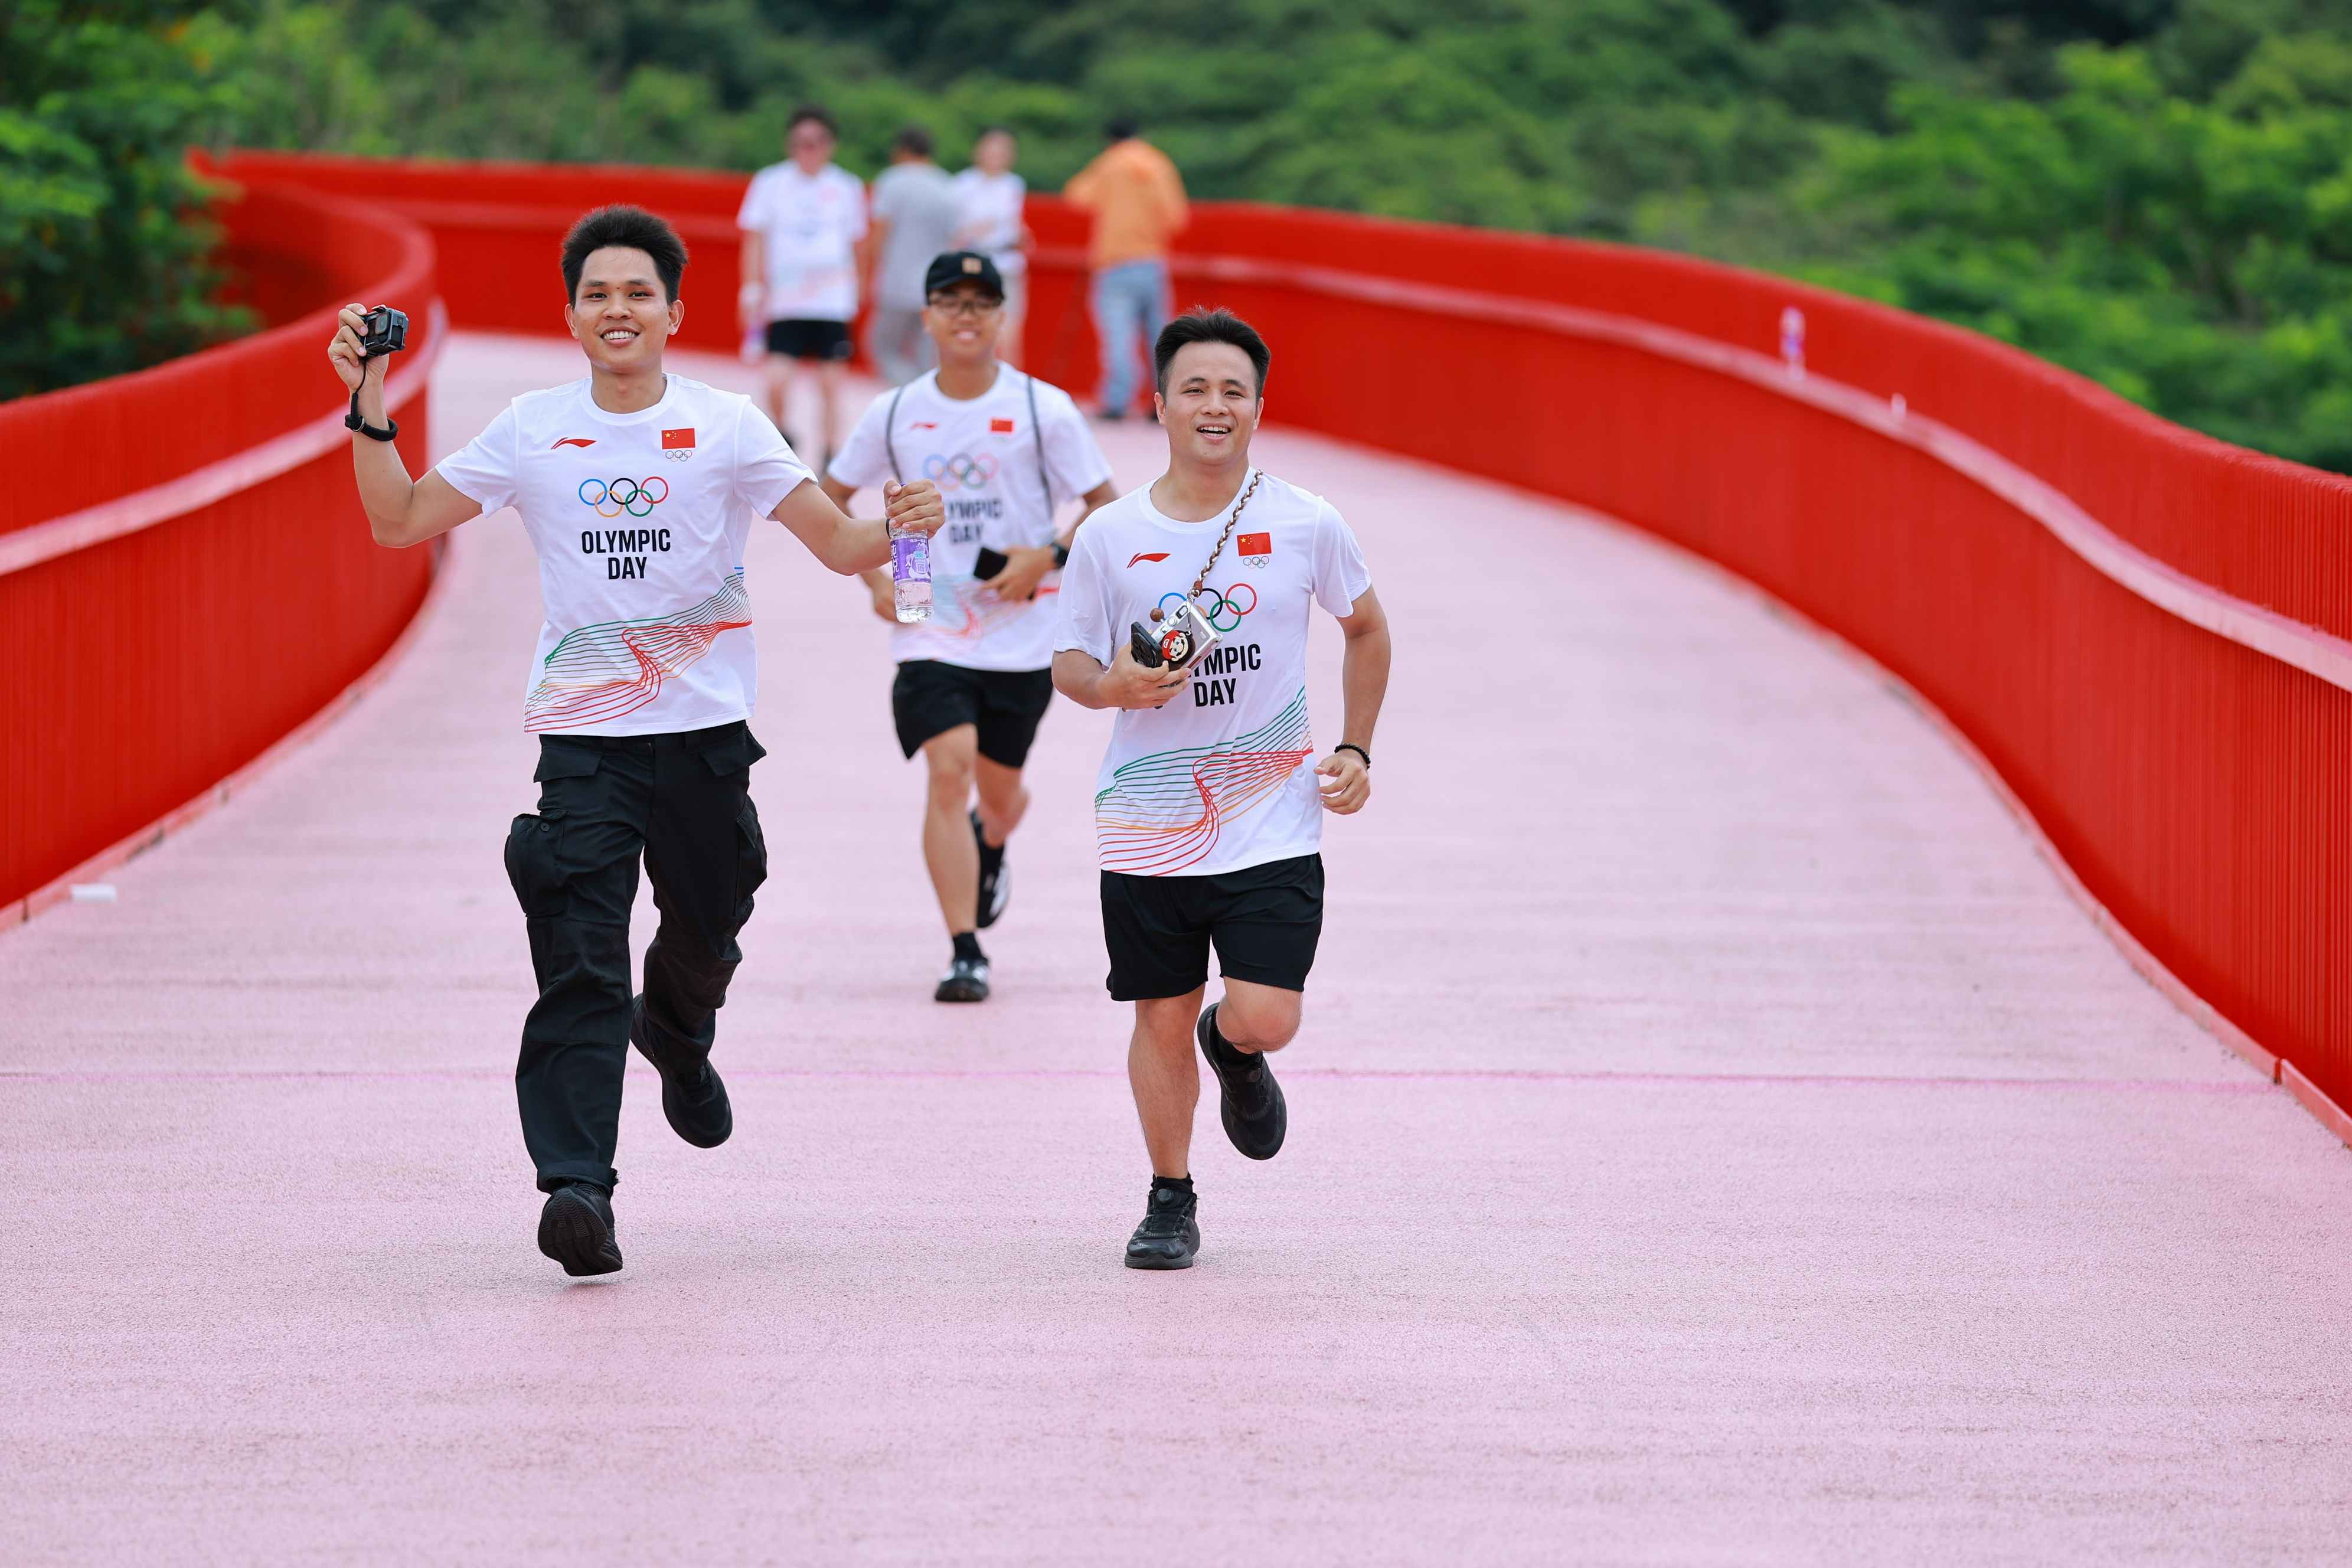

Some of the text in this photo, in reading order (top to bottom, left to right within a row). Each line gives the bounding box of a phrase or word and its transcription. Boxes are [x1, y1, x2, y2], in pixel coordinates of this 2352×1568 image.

[945, 499, 1002, 519] YMPIC
[582, 528, 671, 554] OLYMPIC
[949, 524, 984, 543] DAY
[607, 557, 647, 579] DAY
[1188, 643, 1261, 678] MPIC
[1194, 678, 1236, 707] DAY
